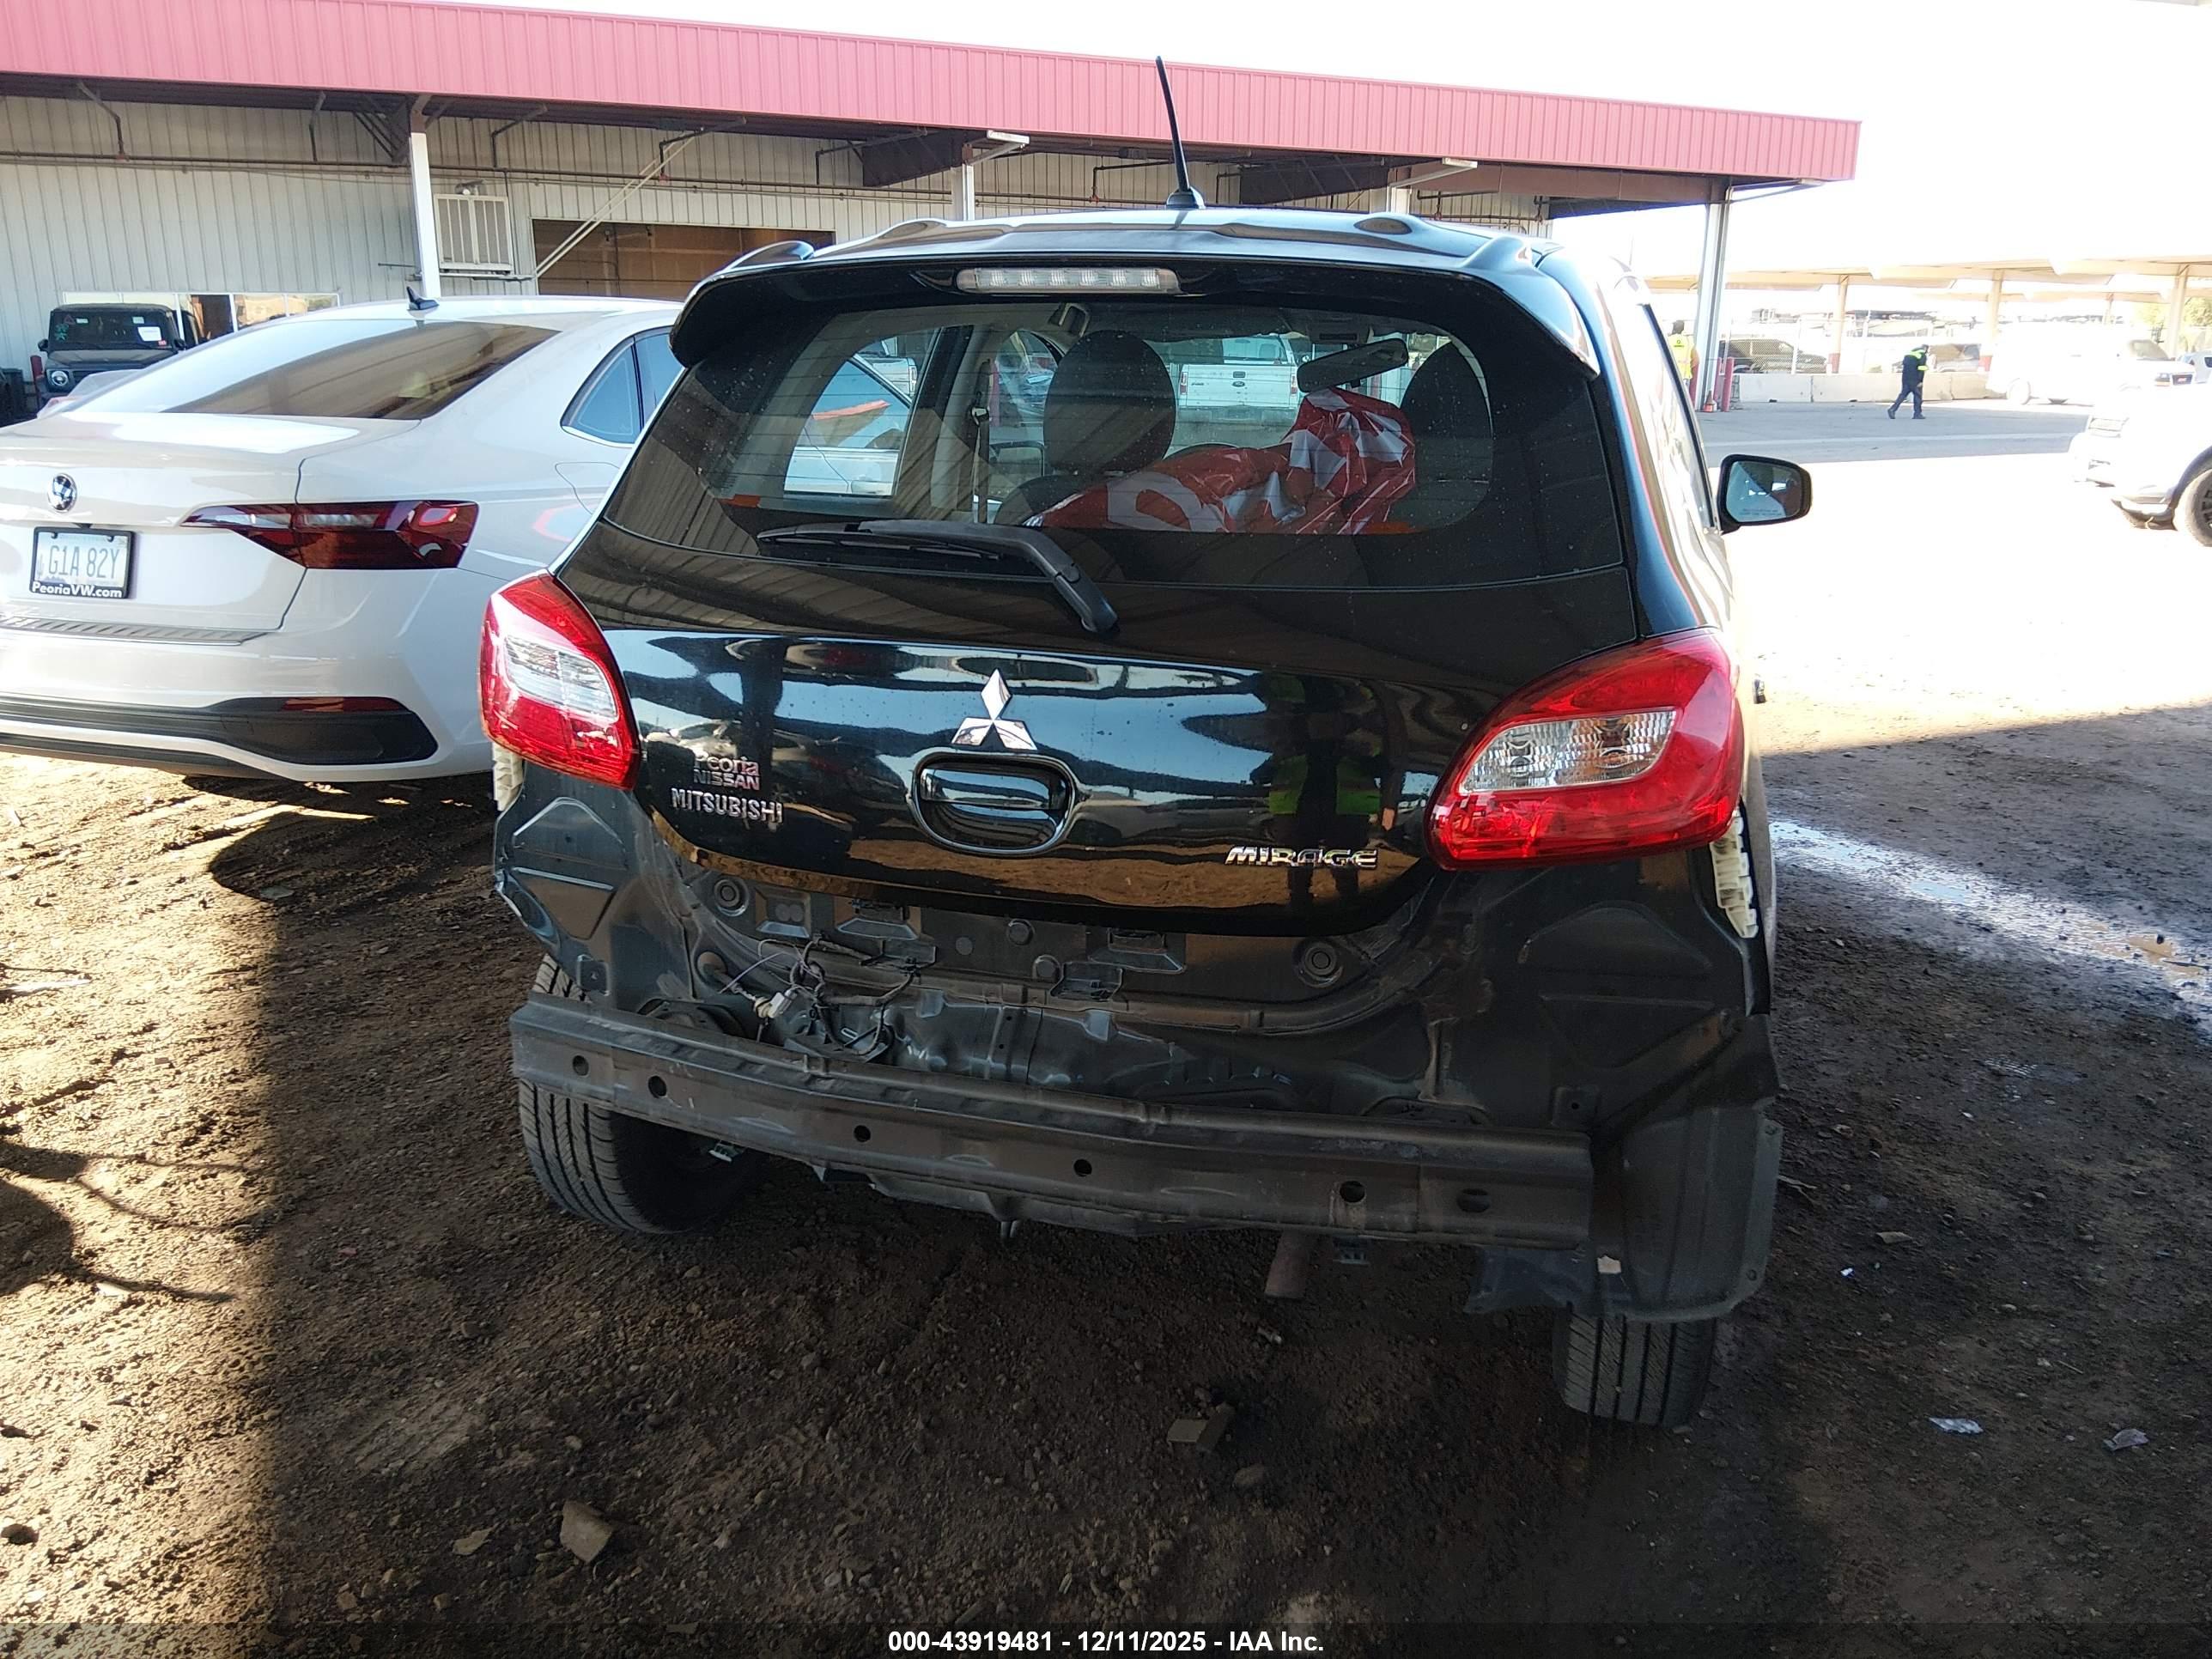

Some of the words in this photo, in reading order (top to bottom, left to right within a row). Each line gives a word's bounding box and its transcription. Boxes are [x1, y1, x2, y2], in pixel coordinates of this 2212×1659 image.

[48, 544, 80, 577] G1A
[86, 547, 119, 579] 82Y
[32, 580, 123, 598] PeoriaVW.com
[694, 750, 759, 776] Peoria
[693, 769, 760, 790] NISSAN
[671, 787, 783, 823] MITSUBISHI
[1224, 846, 1377, 868] MIRAGE
